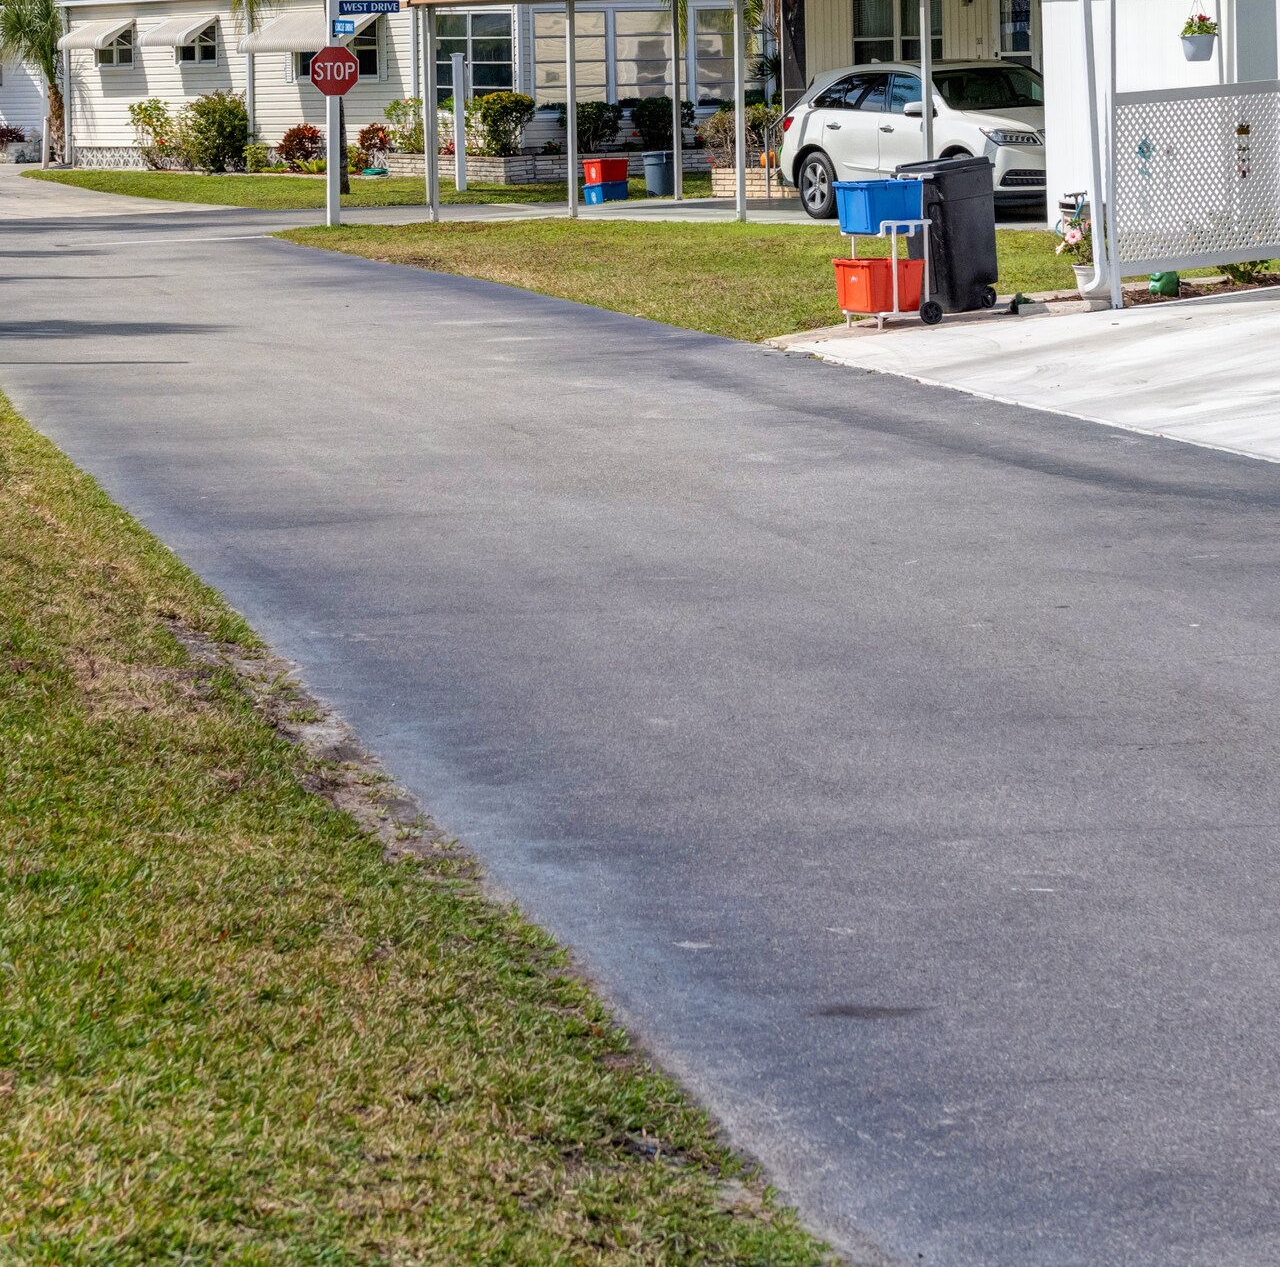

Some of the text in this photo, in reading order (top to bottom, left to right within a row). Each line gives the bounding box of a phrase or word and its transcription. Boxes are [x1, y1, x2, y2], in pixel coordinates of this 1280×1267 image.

[343, 2, 399, 11] WEST DRIVE
[314, 62, 355, 80] STOP
